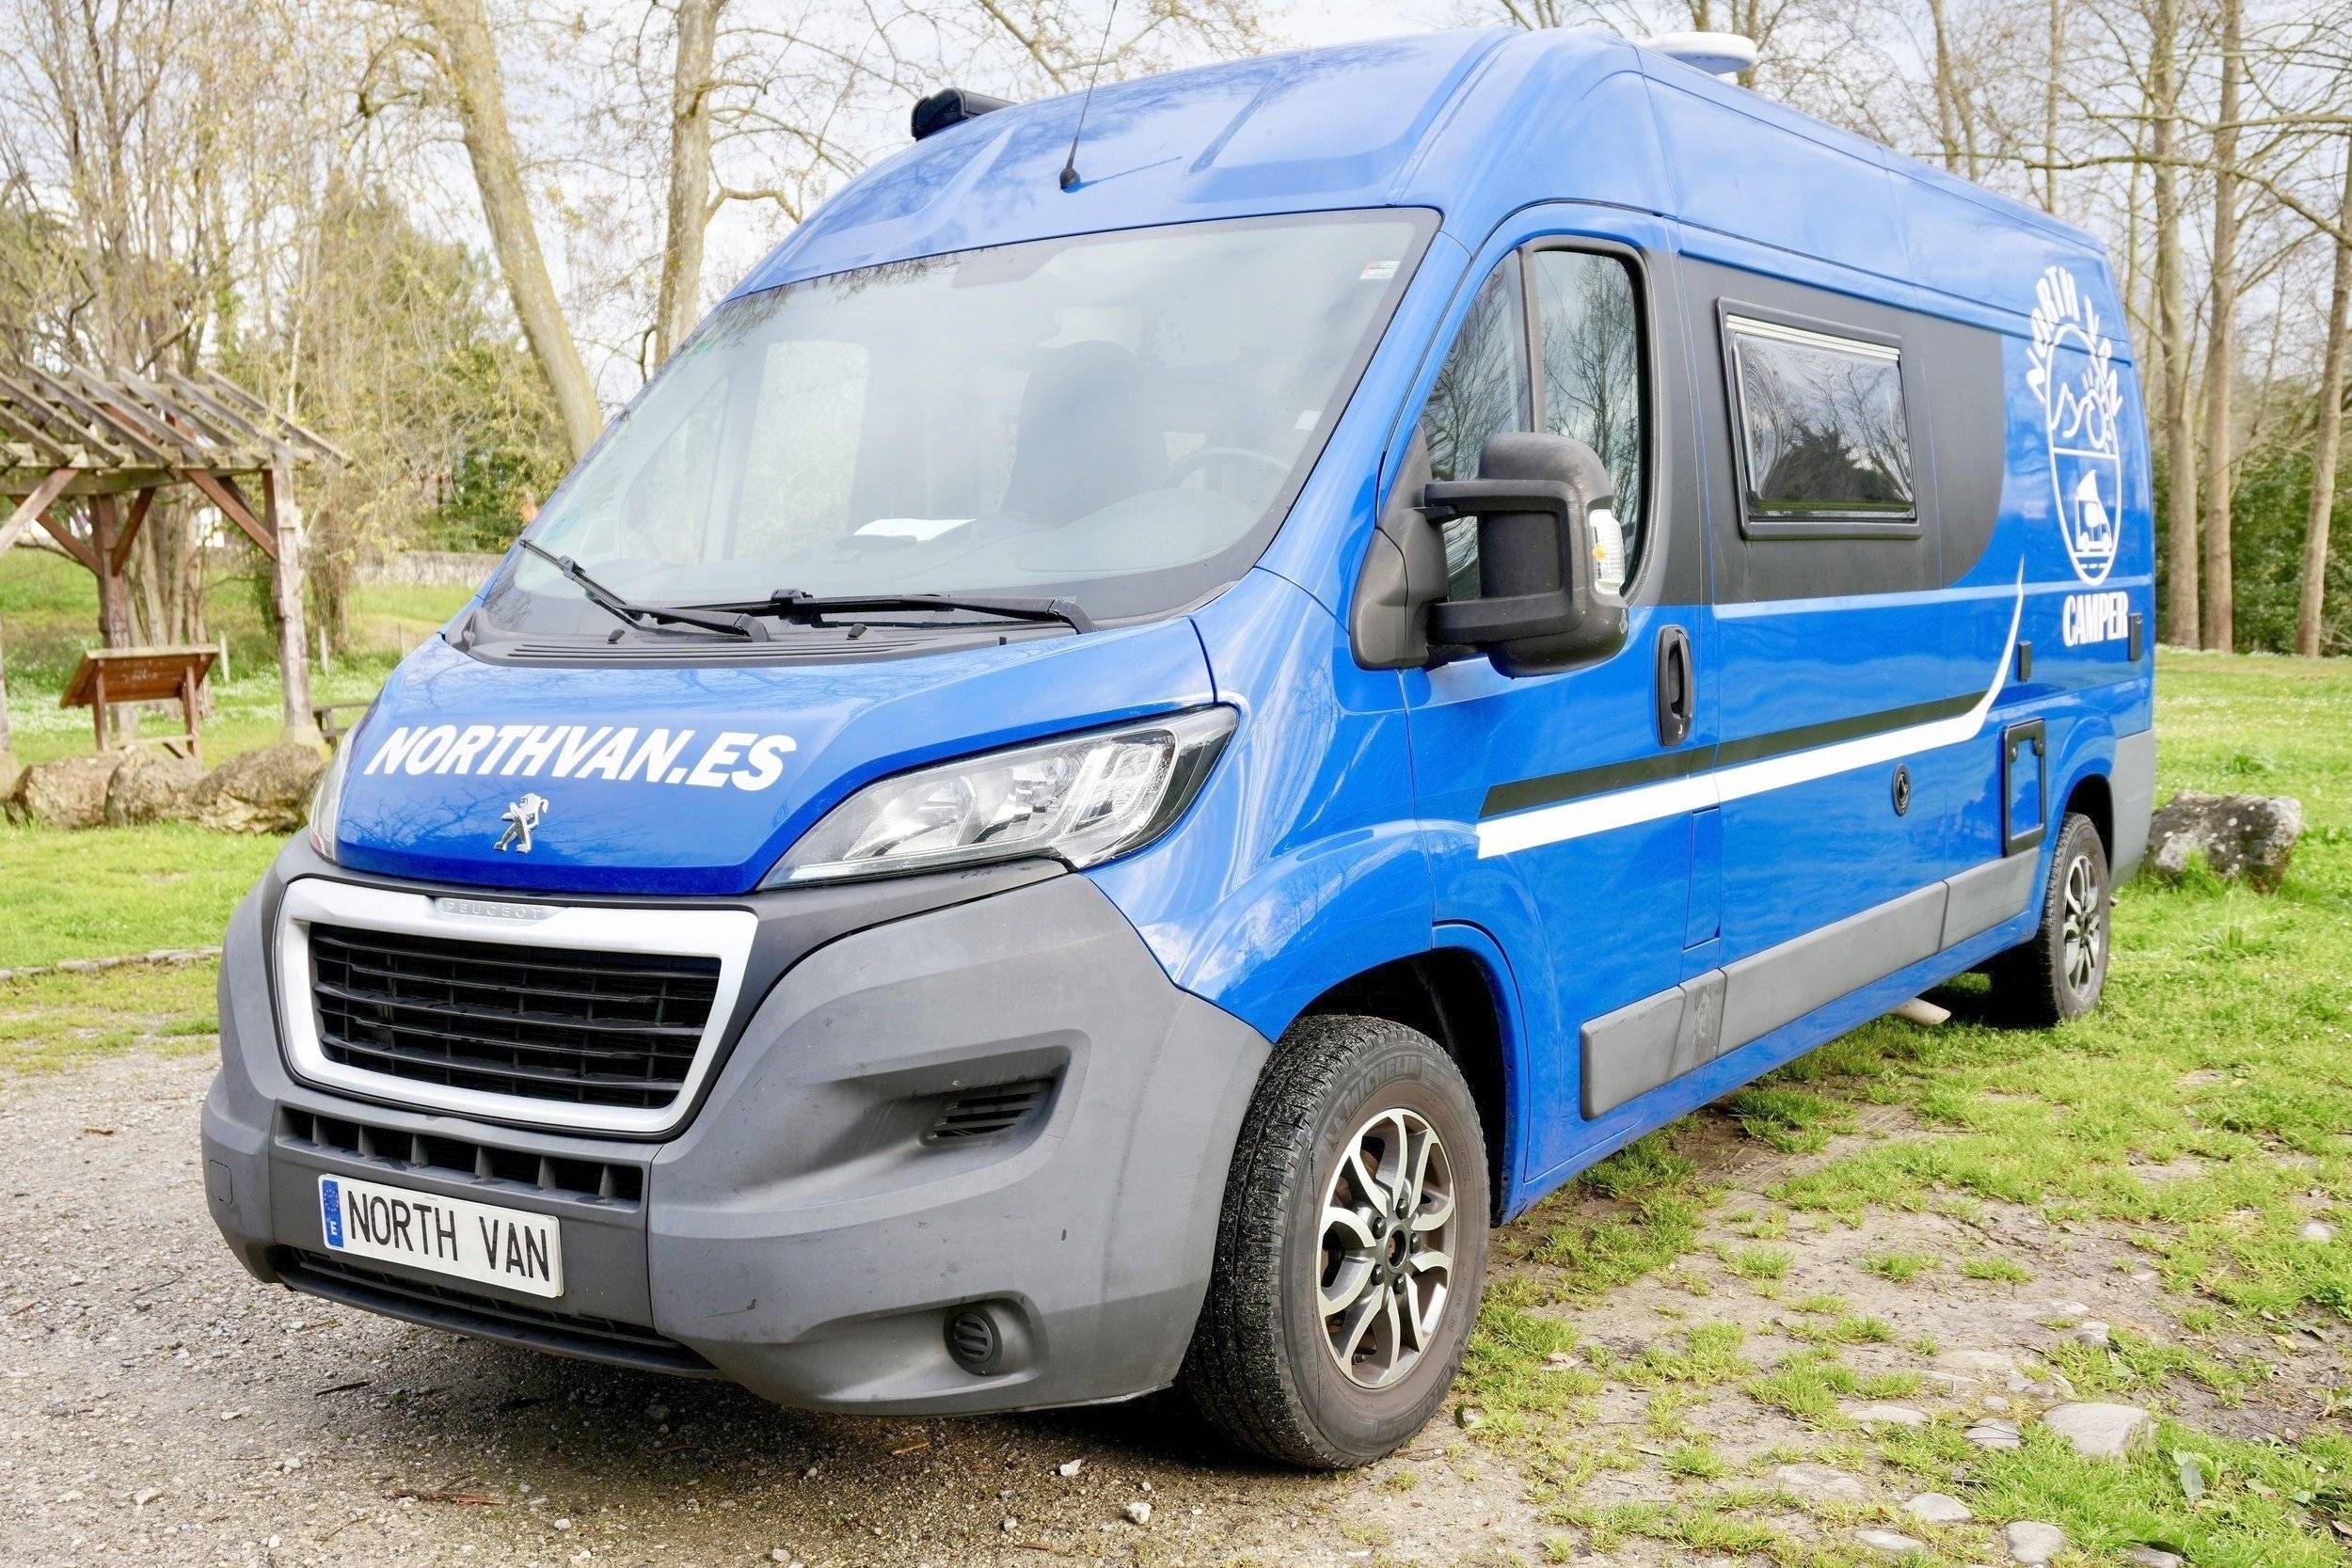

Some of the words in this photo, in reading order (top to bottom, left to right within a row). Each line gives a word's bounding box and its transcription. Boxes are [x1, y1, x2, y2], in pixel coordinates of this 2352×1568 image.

[2026, 265, 2081, 404] NORTH
[2062, 591, 2129, 647] CAMPER
[363, 724, 797, 791] NORTHVAN.ES
[444, 901, 542, 919] PEUGEOT
[1343, 1054, 1422, 1116] MICHELIN
[330, 1220, 338, 1236] E
[347, 1190, 458, 1261] NORTH
[478, 1215, 549, 1282] VAN
